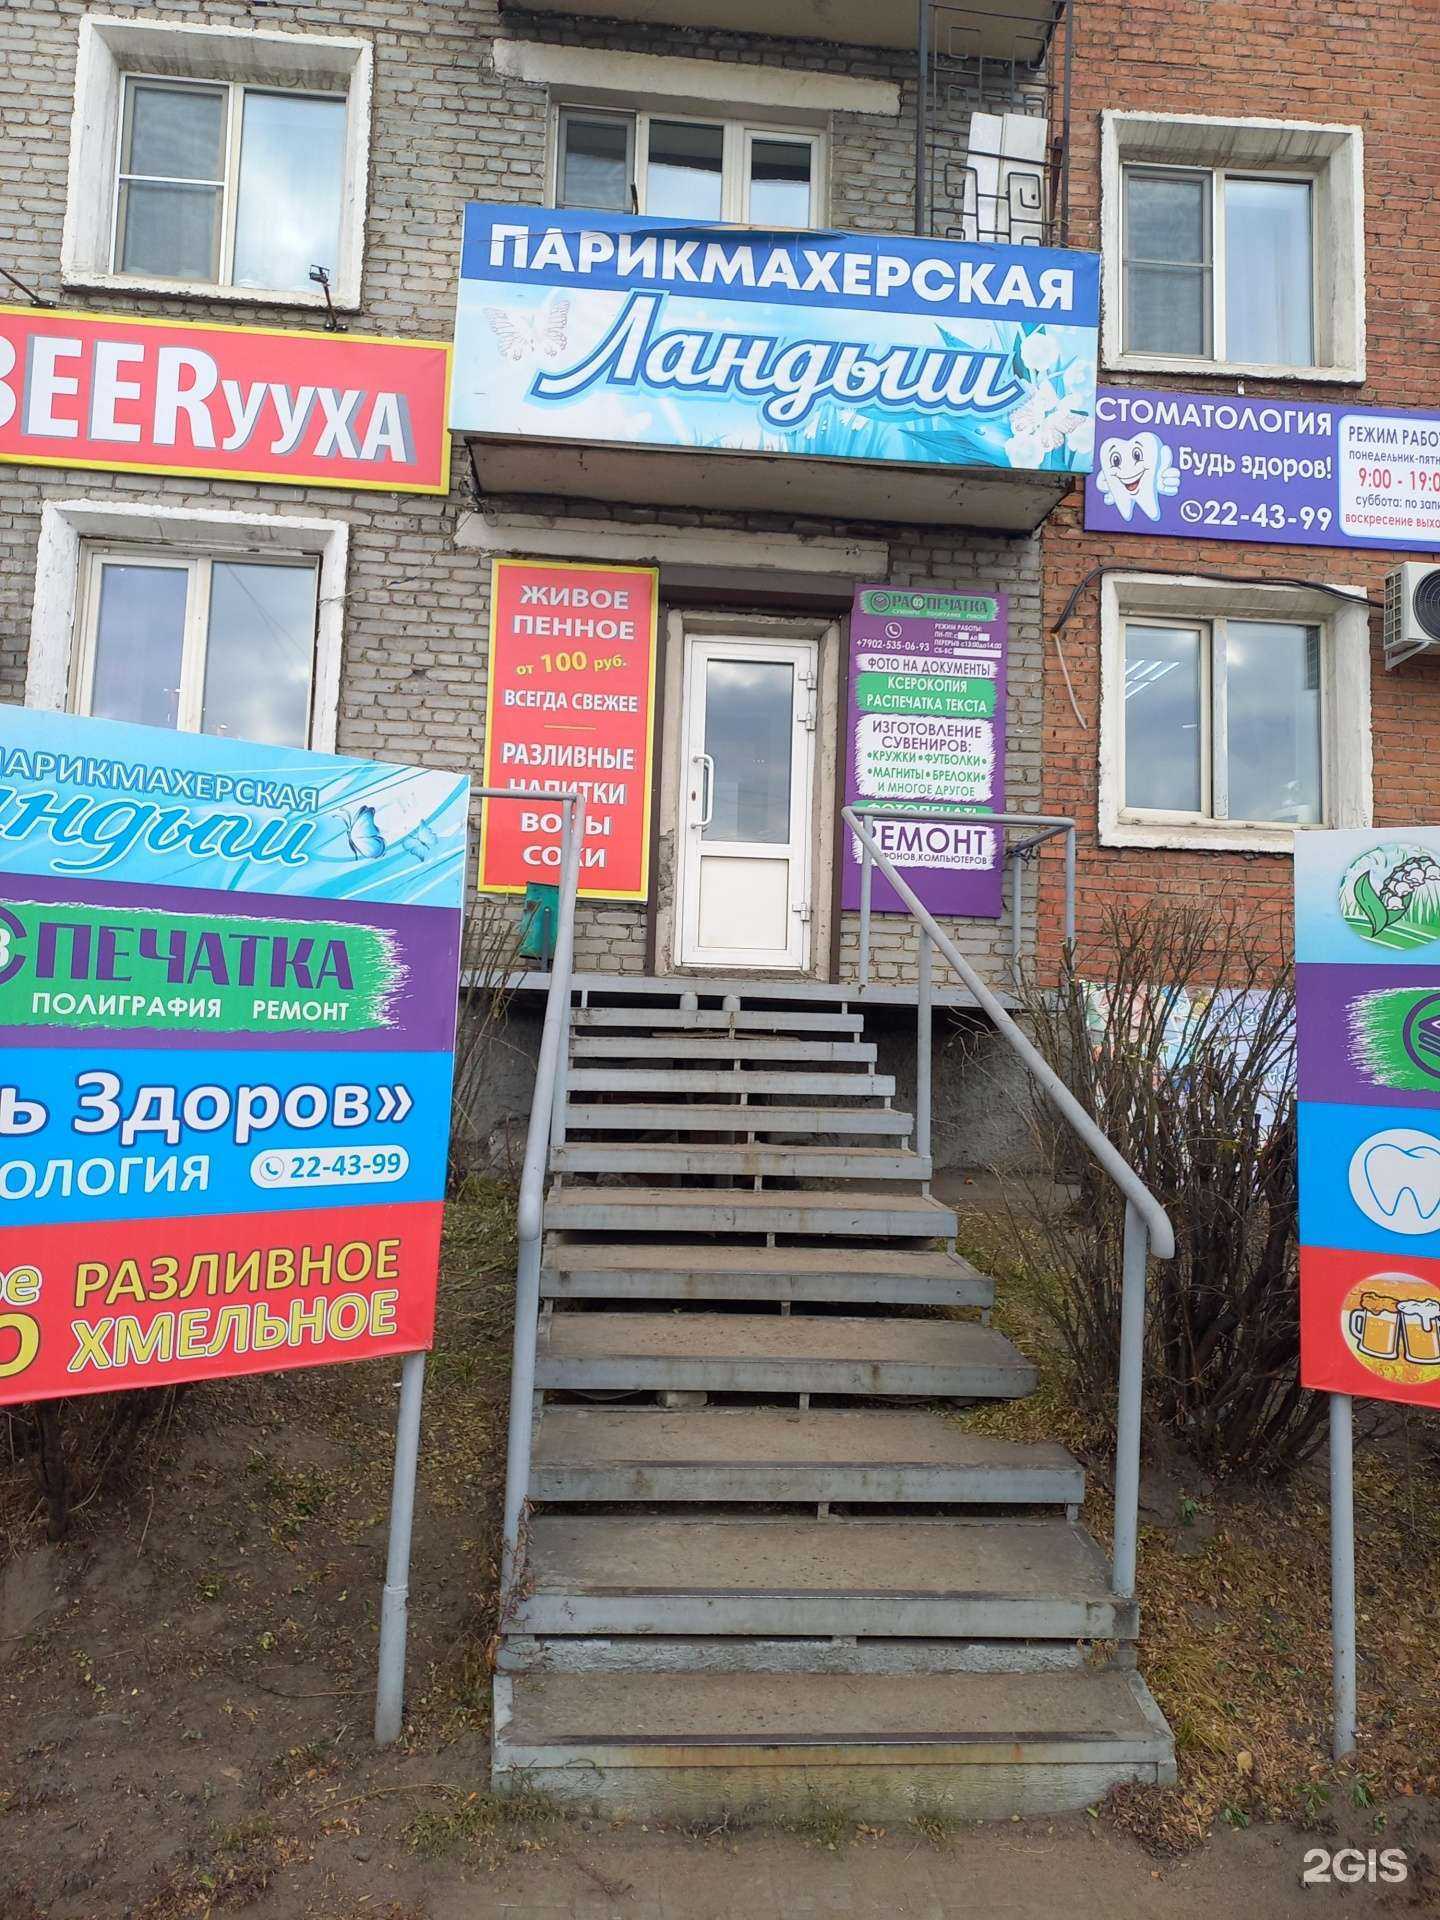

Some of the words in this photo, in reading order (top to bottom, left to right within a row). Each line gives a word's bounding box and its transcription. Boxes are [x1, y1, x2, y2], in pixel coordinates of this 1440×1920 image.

[490, 223, 1075, 311] ПАРИКМАХЕРСКАЯ
[531, 289, 1025, 427] Ландыш
[1095, 397, 1332, 436] СТОМАТОЛОГИЯ
[1348, 426, 1398, 445] РЕЖИМ
[1402, 429, 1440, 448] РАБО
[1179, 446, 1236, 478] Будь
[1240, 455, 1333, 482] здоров!
[1358, 467, 1392, 489] 9:00
[1355, 494, 1402, 509] суббота:
[1405, 499, 1417, 509] по
[1203, 500, 1333, 533] 22-43-99
[1345, 513, 1413, 527] воскресение
[519, 584, 629, 611] ЖИВОЕ
[511, 613, 635, 641] ПЕННОЕ
[856, 638, 930, 652] +7902-535-06-93
[515, 663, 534, 677] от
[541, 650, 588, 673] 100
[593, 653, 627, 673] руб.
[867, 657, 899, 670] ФОТО
[903, 659, 918, 672] НА
[920, 660, 990, 676] ДОКУМЕНТЫ
[887, 676, 968, 693] КСЕРОКОПИЯ
[503, 688, 568, 711] ВСЕГДА
[570, 691, 638, 713] СВЕЖЕЕ
[866, 693, 943, 711] РАСПЕЧАТКА
[945, 698, 988, 713] ТЕКСТА
[872, 719, 981, 738] ИЗГОТОВЛЕНИЕ
[501, 741, 635, 771] РАЗЛИВНЫЕ
[881, 735, 972, 752] СУВЕНИРОВ:
[878, 782, 885, 791] И
[887, 783, 931, 795] МНОГОЕ
[935, 785, 975, 798] ДРУГОЕ
[520, 811, 612, 836] ВОЫ
[872, 825, 987, 856] ЕМОНТ
[32, 992, 222, 1019] ПОЛИГРАФИЯ
[252, 1000, 350, 1022] РЕМОНТ
[72, 1070, 414, 1146] Здоров»
[290, 1152, 401, 1180] 22-43-99
[74, 1239, 401, 1308] РАЗЛИВНОЕ
[67, 1288, 400, 1374] ХМЕЛЬНОЕ
